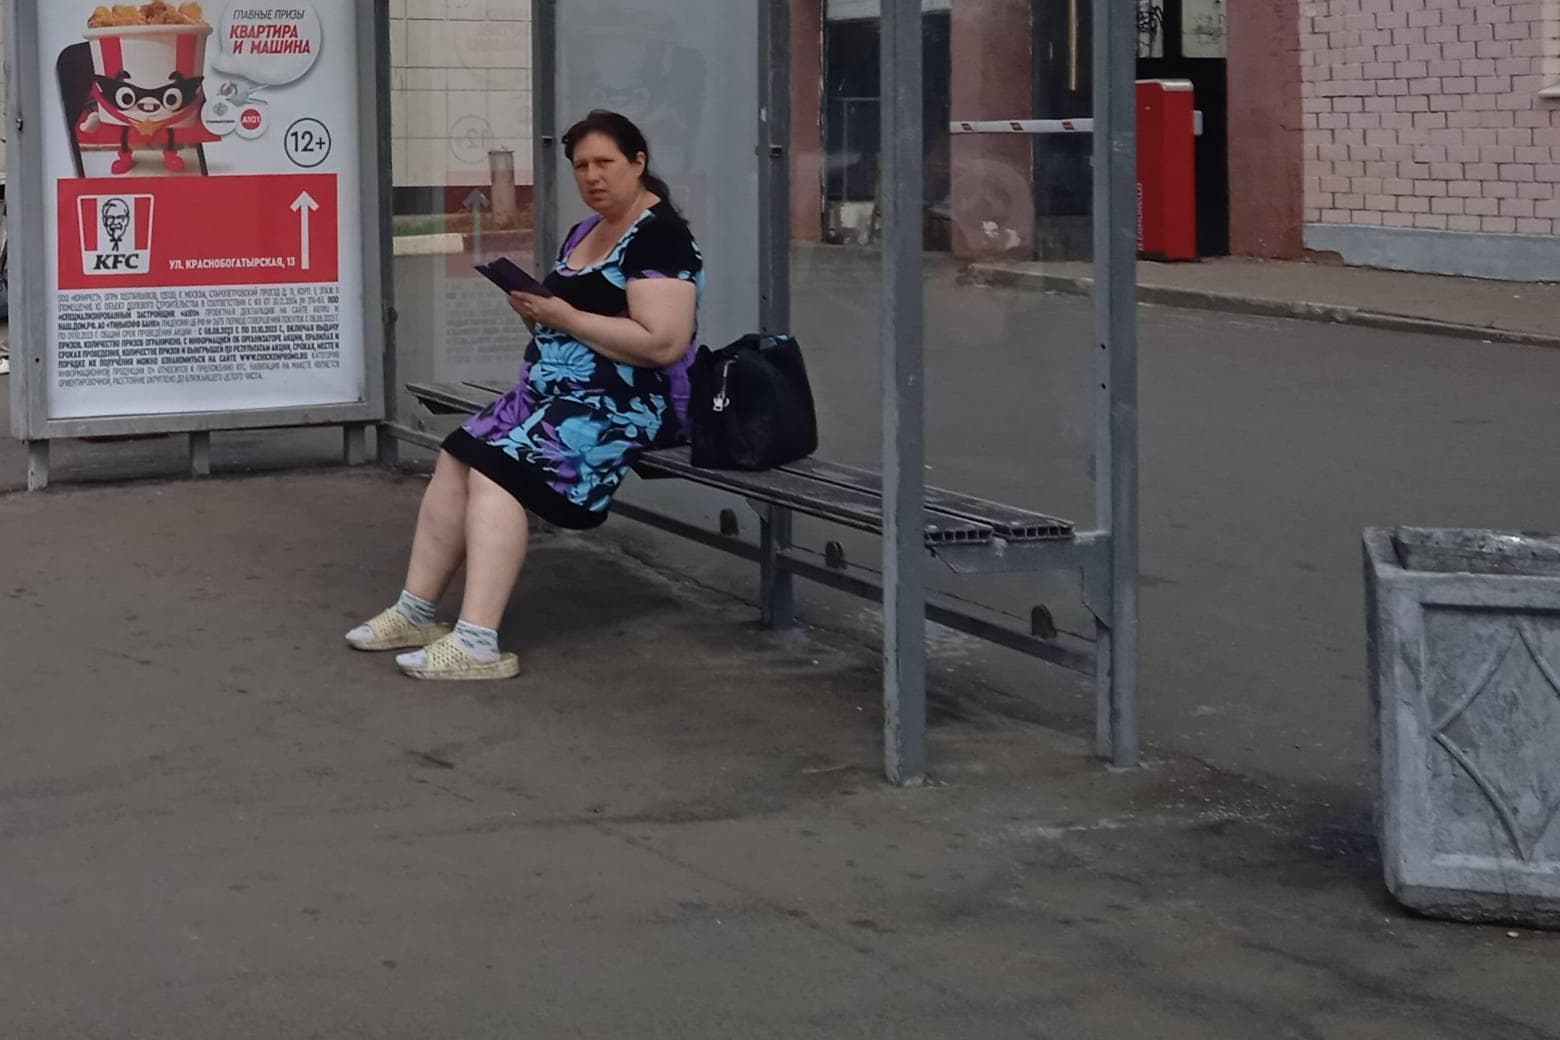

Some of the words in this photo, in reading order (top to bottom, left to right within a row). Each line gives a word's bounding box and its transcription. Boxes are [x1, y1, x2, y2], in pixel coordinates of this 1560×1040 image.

[233, 9, 273, 20] ГЛАВНЫЕ
[274, 9, 305, 20] ПРИЗЫ
[230, 24, 299, 39] КВАРТИРА
[232, 39, 244, 54] И
[250, 39, 311, 54] МАШИНА
[242, 115, 261, 124] А101
[290, 130, 327, 153] 12+
[92, 253, 140, 271] KFC
[169, 260, 185, 270] УЛ.
[185, 257, 285, 270] КРАСНОБОГАТЫРСКАЯ,
[286, 256, 296, 267] 13
